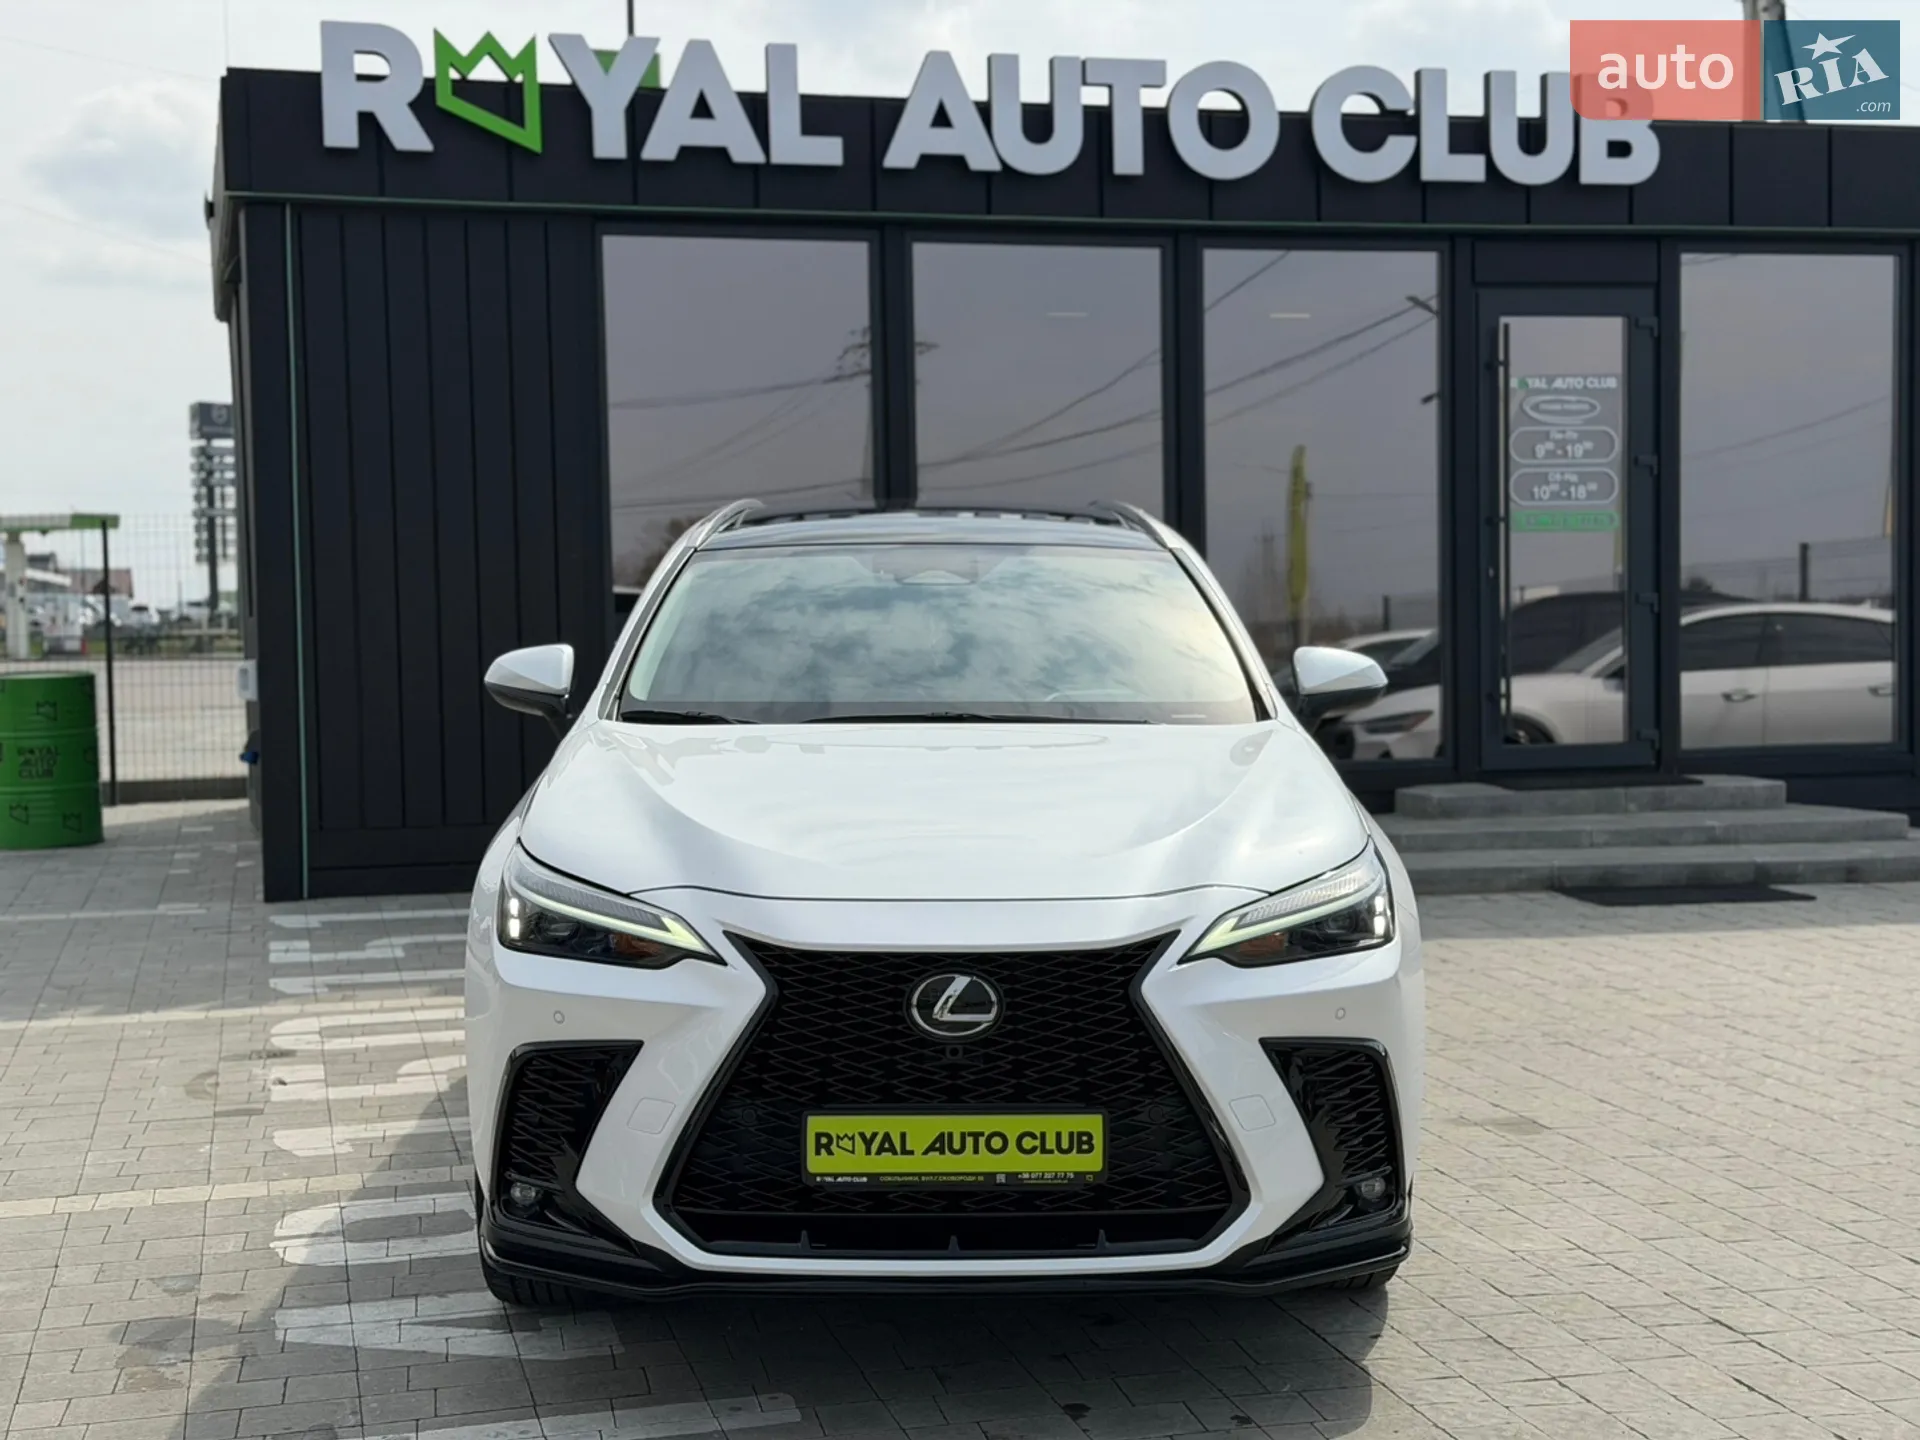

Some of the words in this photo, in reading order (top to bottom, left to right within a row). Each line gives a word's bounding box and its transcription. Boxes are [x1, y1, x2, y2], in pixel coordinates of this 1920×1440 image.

[882, 50, 1280, 180] AUTO
[1310, 64, 1660, 186] CLUB
[1552, 377, 1584, 388] AUTO
[1586, 377, 1618, 388] CLUB
[921, 1131, 1009, 1156] AUTO
[1015, 1131, 1095, 1155] CLUB
